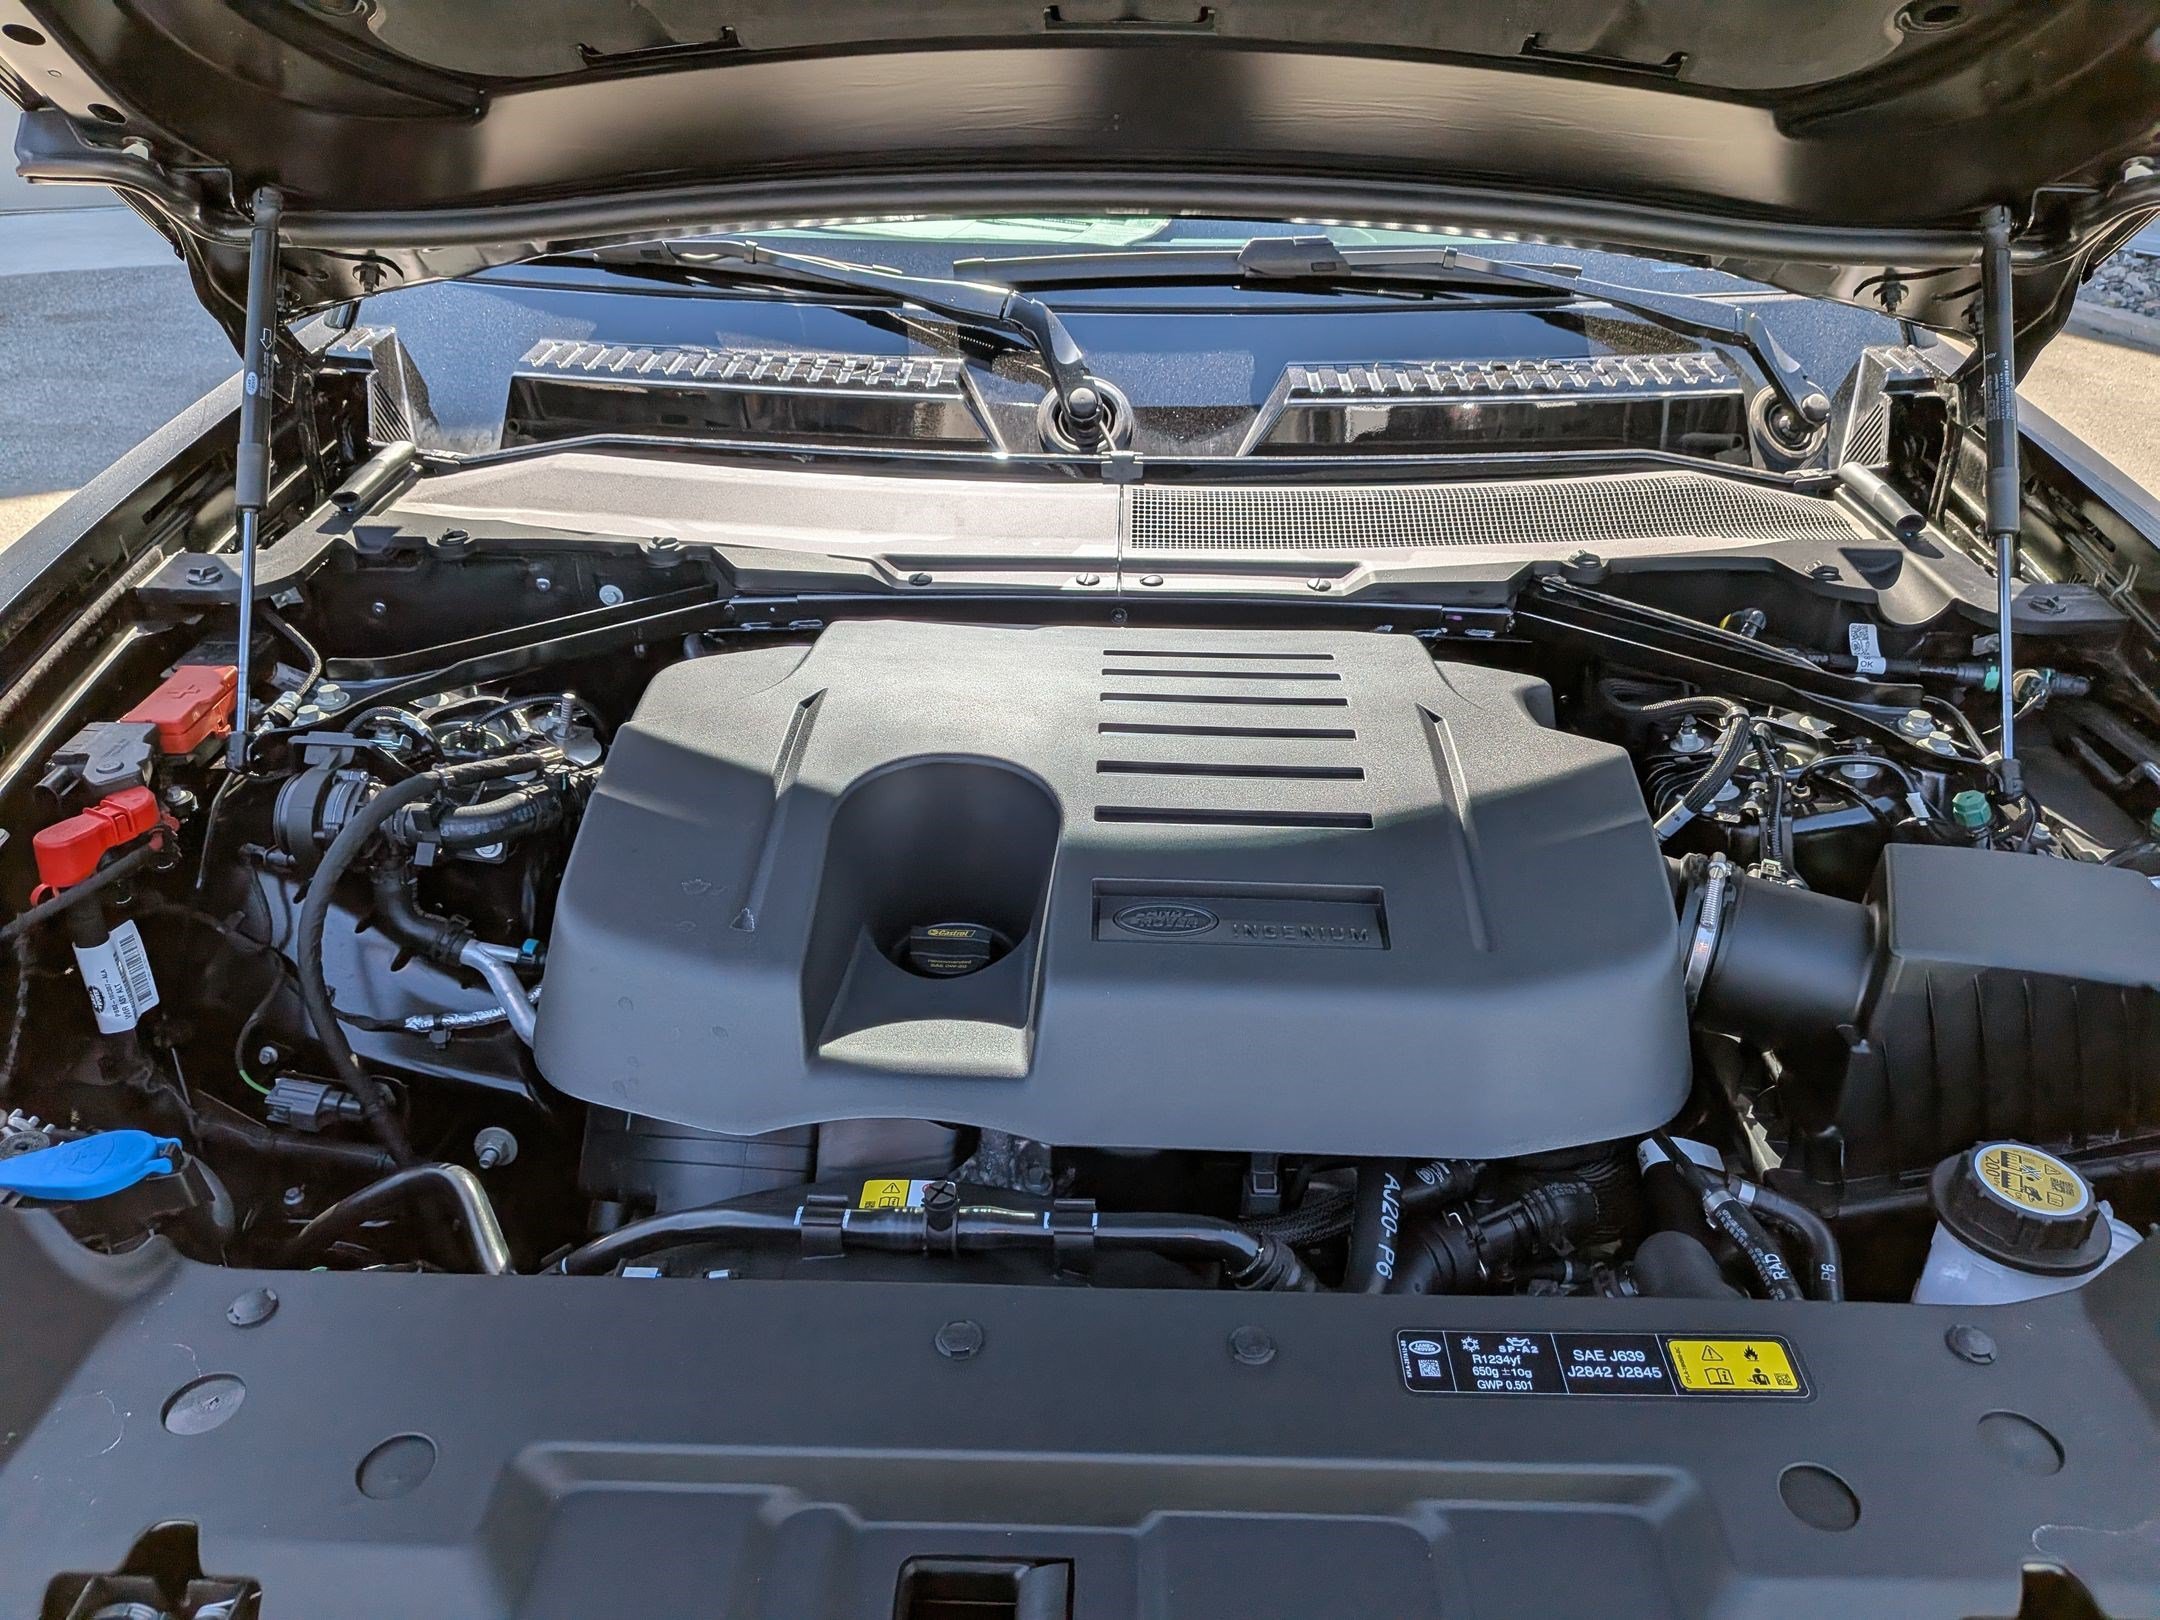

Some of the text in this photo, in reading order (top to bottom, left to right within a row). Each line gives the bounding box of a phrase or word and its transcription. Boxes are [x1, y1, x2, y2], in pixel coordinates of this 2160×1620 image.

[1860, 660, 1874, 668] OK
[1232, 922, 1370, 942] INGENIUM
[1985, 1155, 2000, 1177] 200
[1764, 1253, 1789, 1281] RAD
[1498, 1345, 1539, 1354] SP-A2
[1573, 1349, 1646, 1362] SAE J639
[1472, 1354, 1521, 1367] R1234yf
[1472, 1366, 1499, 1378] 650g
[1567, 1366, 1662, 1379] J2842 J2845
[1477, 1380, 1533, 1391] GWP 0.501
